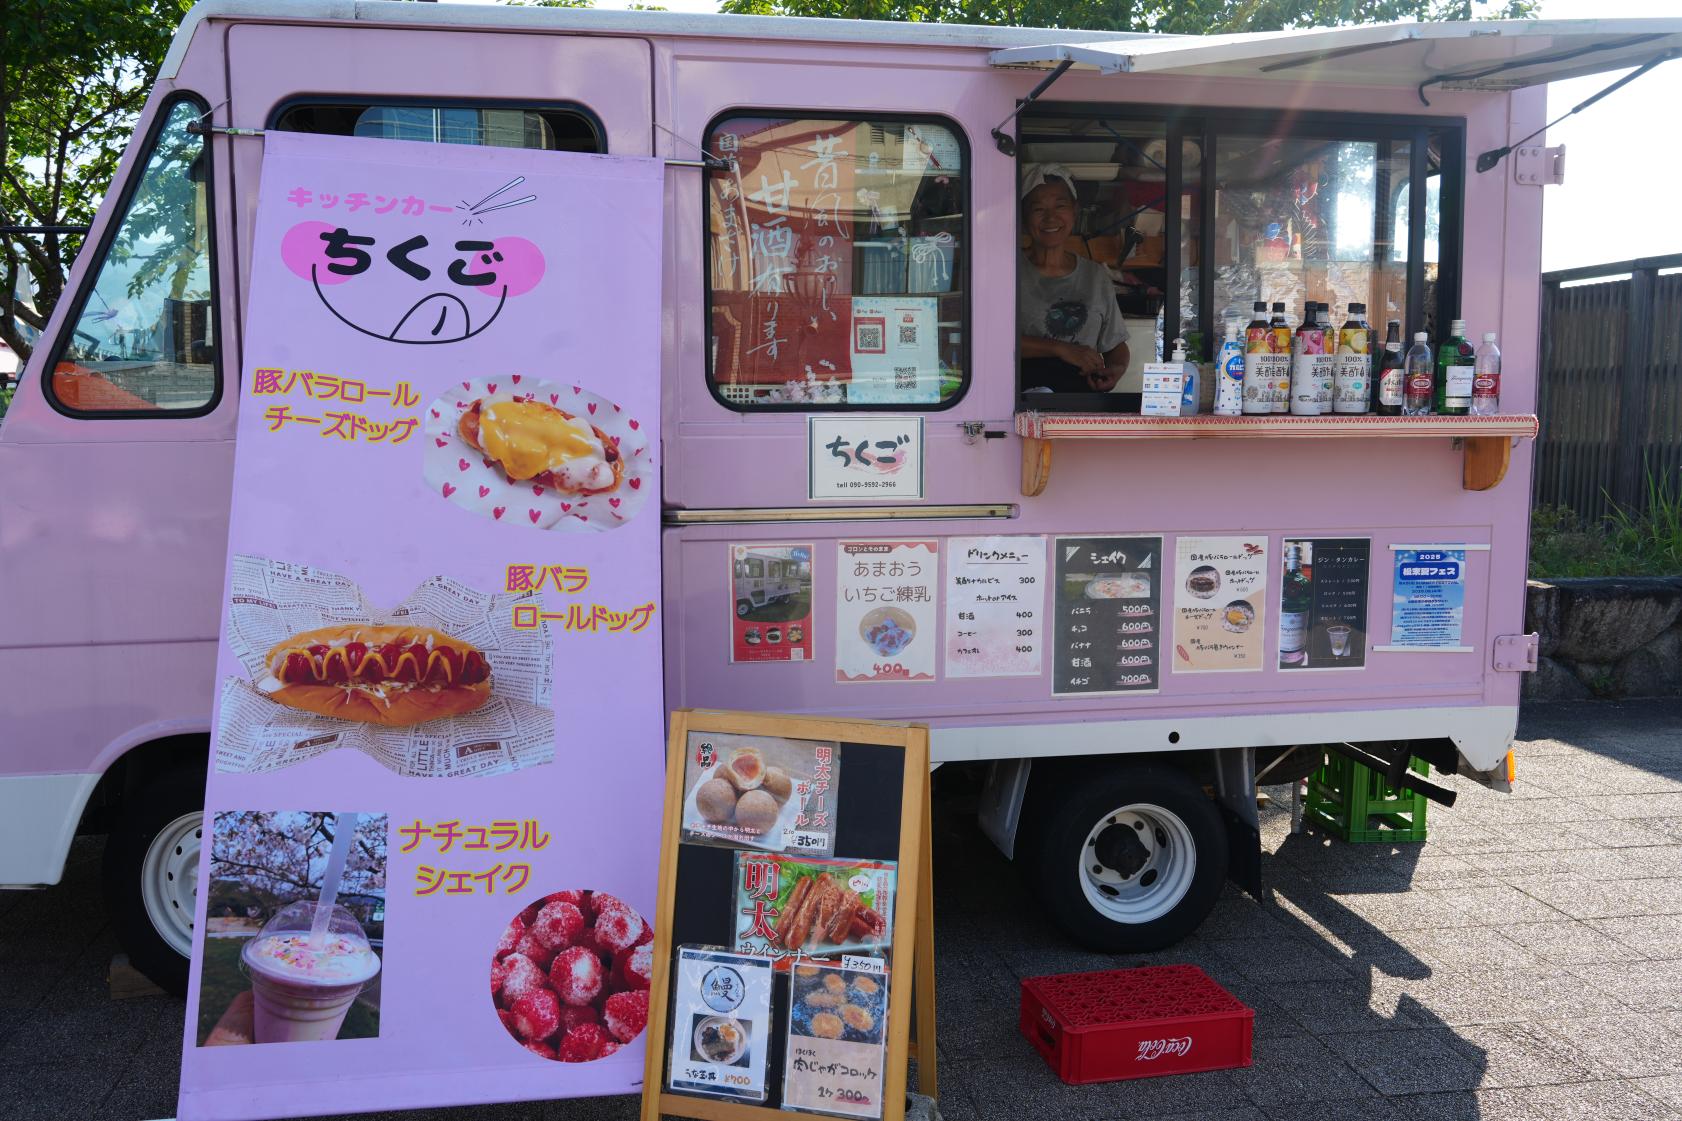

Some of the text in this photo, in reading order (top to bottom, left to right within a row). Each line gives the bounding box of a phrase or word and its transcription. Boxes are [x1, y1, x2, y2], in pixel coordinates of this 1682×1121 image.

[287, 187, 454, 216] キッチンカー
[319, 228, 504, 286] ちくご
[252, 368, 421, 409] 豚バラロール
[264, 405, 421, 444] チーズドッグ
[825, 434, 910, 467] ちくご
[967, 548, 1029, 561] ドリンクメニュー
[1090, 551, 1126, 565] シェイク
[270, 571, 292, 580] HAVE
[304, 577, 332, 585] GREAT
[506, 563, 590, 593] 豚バラ
[853, 560, 922, 577] あまおう
[437, 582, 461, 598] GREAT
[463, 595, 480, 605] DAY
[844, 586, 932, 602] いちご練乳
[512, 601, 656, 633] ロールドッグ
[1071, 604, 1151, 615] バニラ 500円
[1016, 629, 1033, 637] 300
[1071, 622, 1151, 633] チョコ 600円
[1016, 645, 1033, 653] 400
[1070, 638, 1150, 649] バナナ 600円
[1071, 655, 1150, 668] 甘酒 600円
[1070, 674, 1150, 685] イチゴ 700円
[416, 740, 429, 771] LITTLE
[447, 765, 477, 778] GREAT
[480, 759, 500, 769] DAY
[813, 746, 833, 827] 明太チーズ
[795, 781, 812, 827] ボール
[399, 819, 550, 853] ナチュラル
[413, 861, 532, 897] シェイク
[741, 861, 781, 941] 明太
[740, 944, 830, 963] ウインナー
[1136, 1036, 1193, 1061] Coca-Cola
[792, 1058, 878, 1080] 肉じゃがコロッケ
